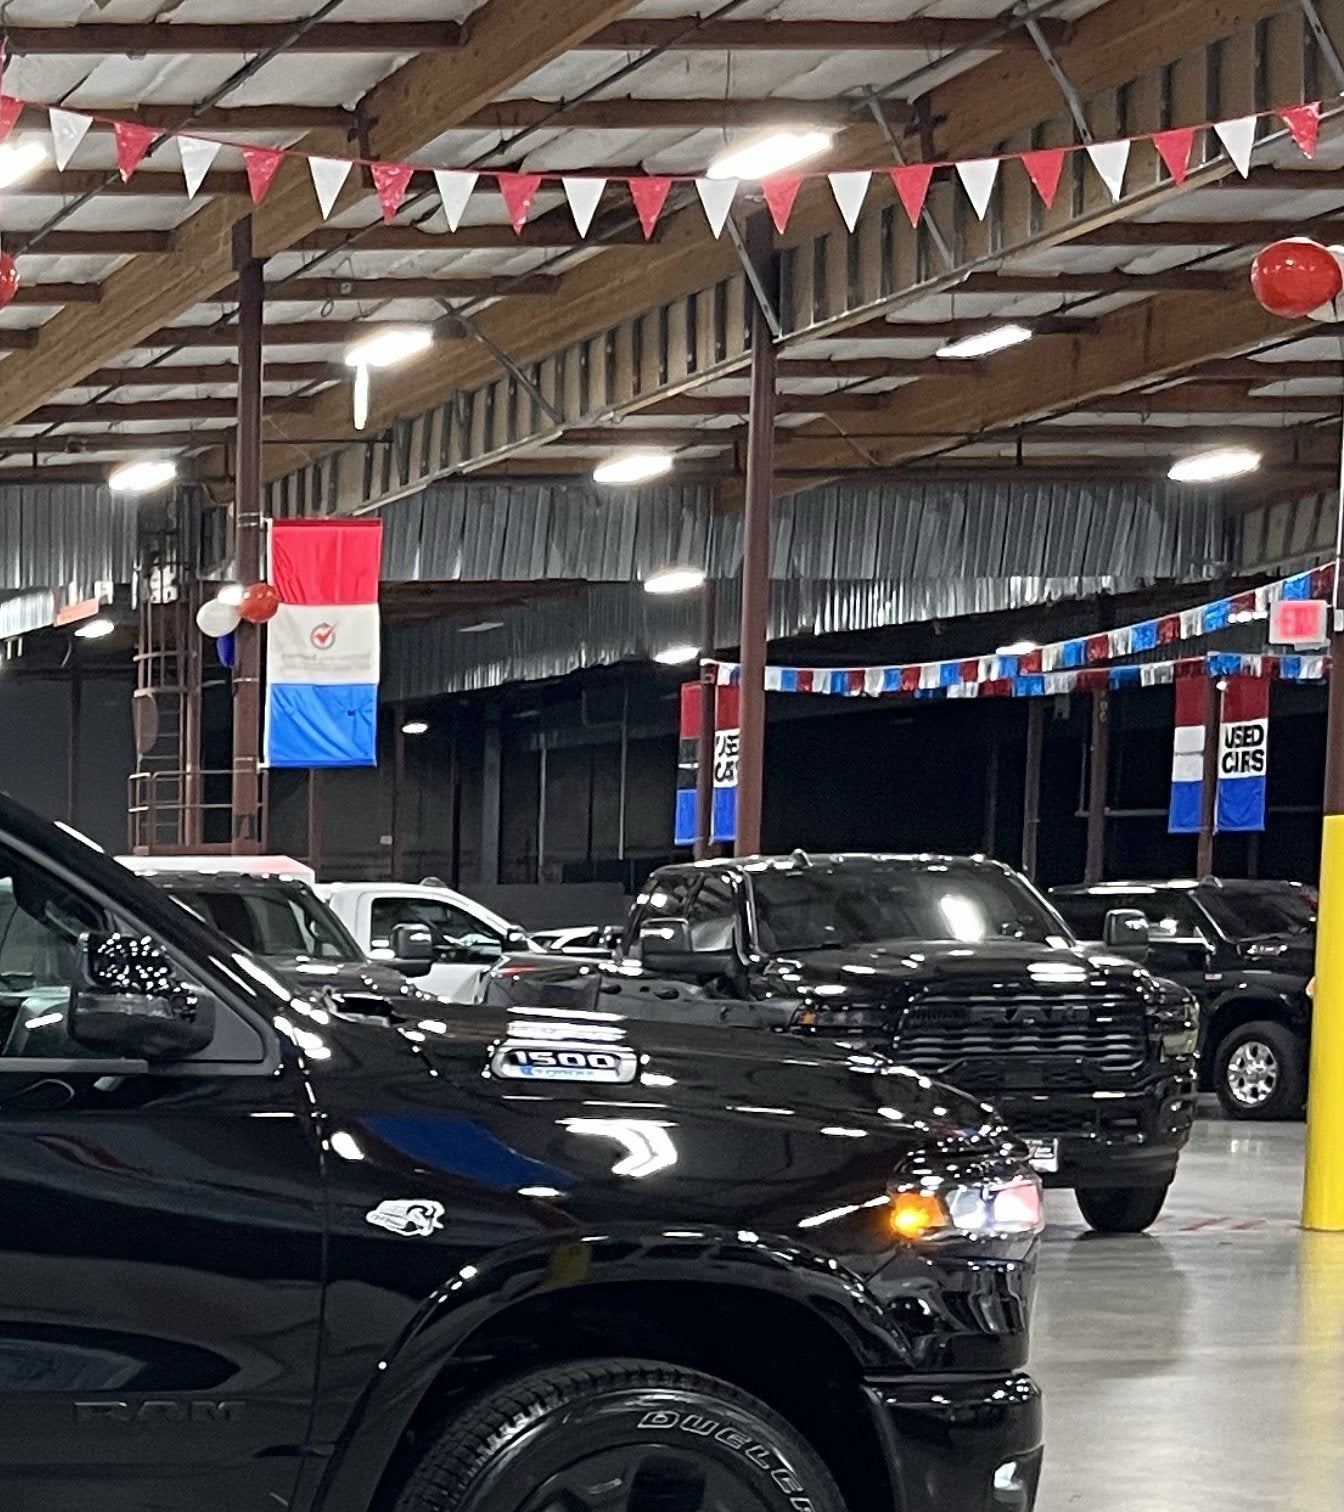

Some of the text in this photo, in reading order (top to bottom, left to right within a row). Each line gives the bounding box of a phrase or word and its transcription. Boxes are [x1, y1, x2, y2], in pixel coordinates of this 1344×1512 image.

[1225, 725, 1265, 749] USED
[515, 1051, 616, 1069] 1500
[74, 1401, 246, 1423] RAM
